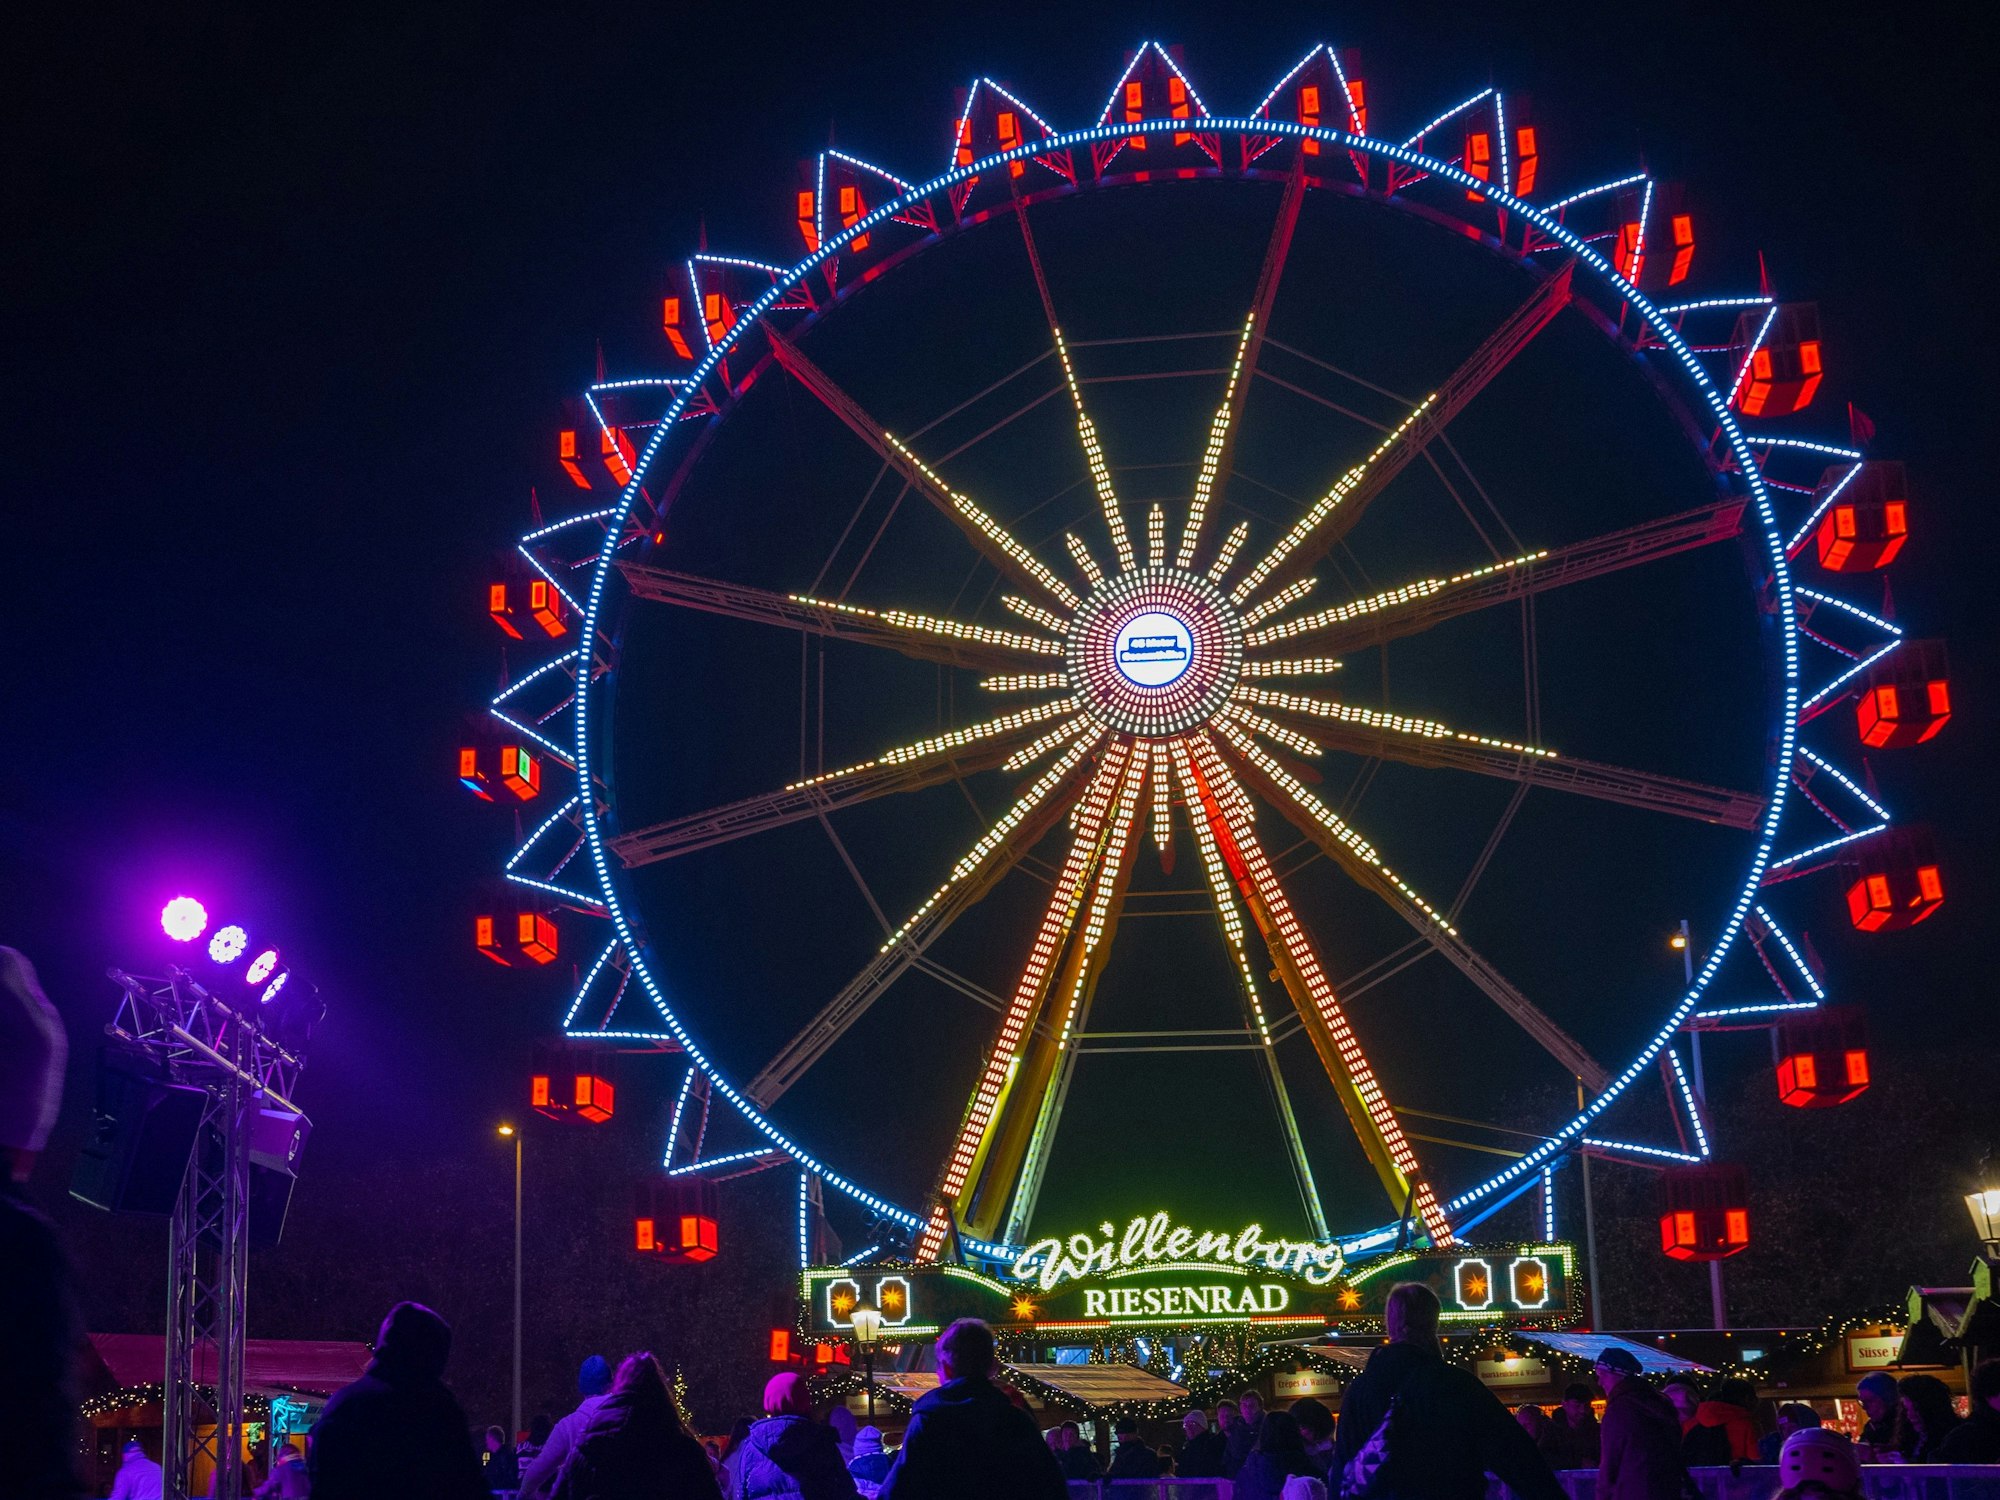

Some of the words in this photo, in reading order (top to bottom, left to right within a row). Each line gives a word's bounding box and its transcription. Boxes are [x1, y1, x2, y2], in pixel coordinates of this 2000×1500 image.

[1011, 1209, 1346, 1290] Willenborg
[1083, 1284, 1290, 1317] RIESENRAD
[1858, 1347, 1889, 1358] Süsse
